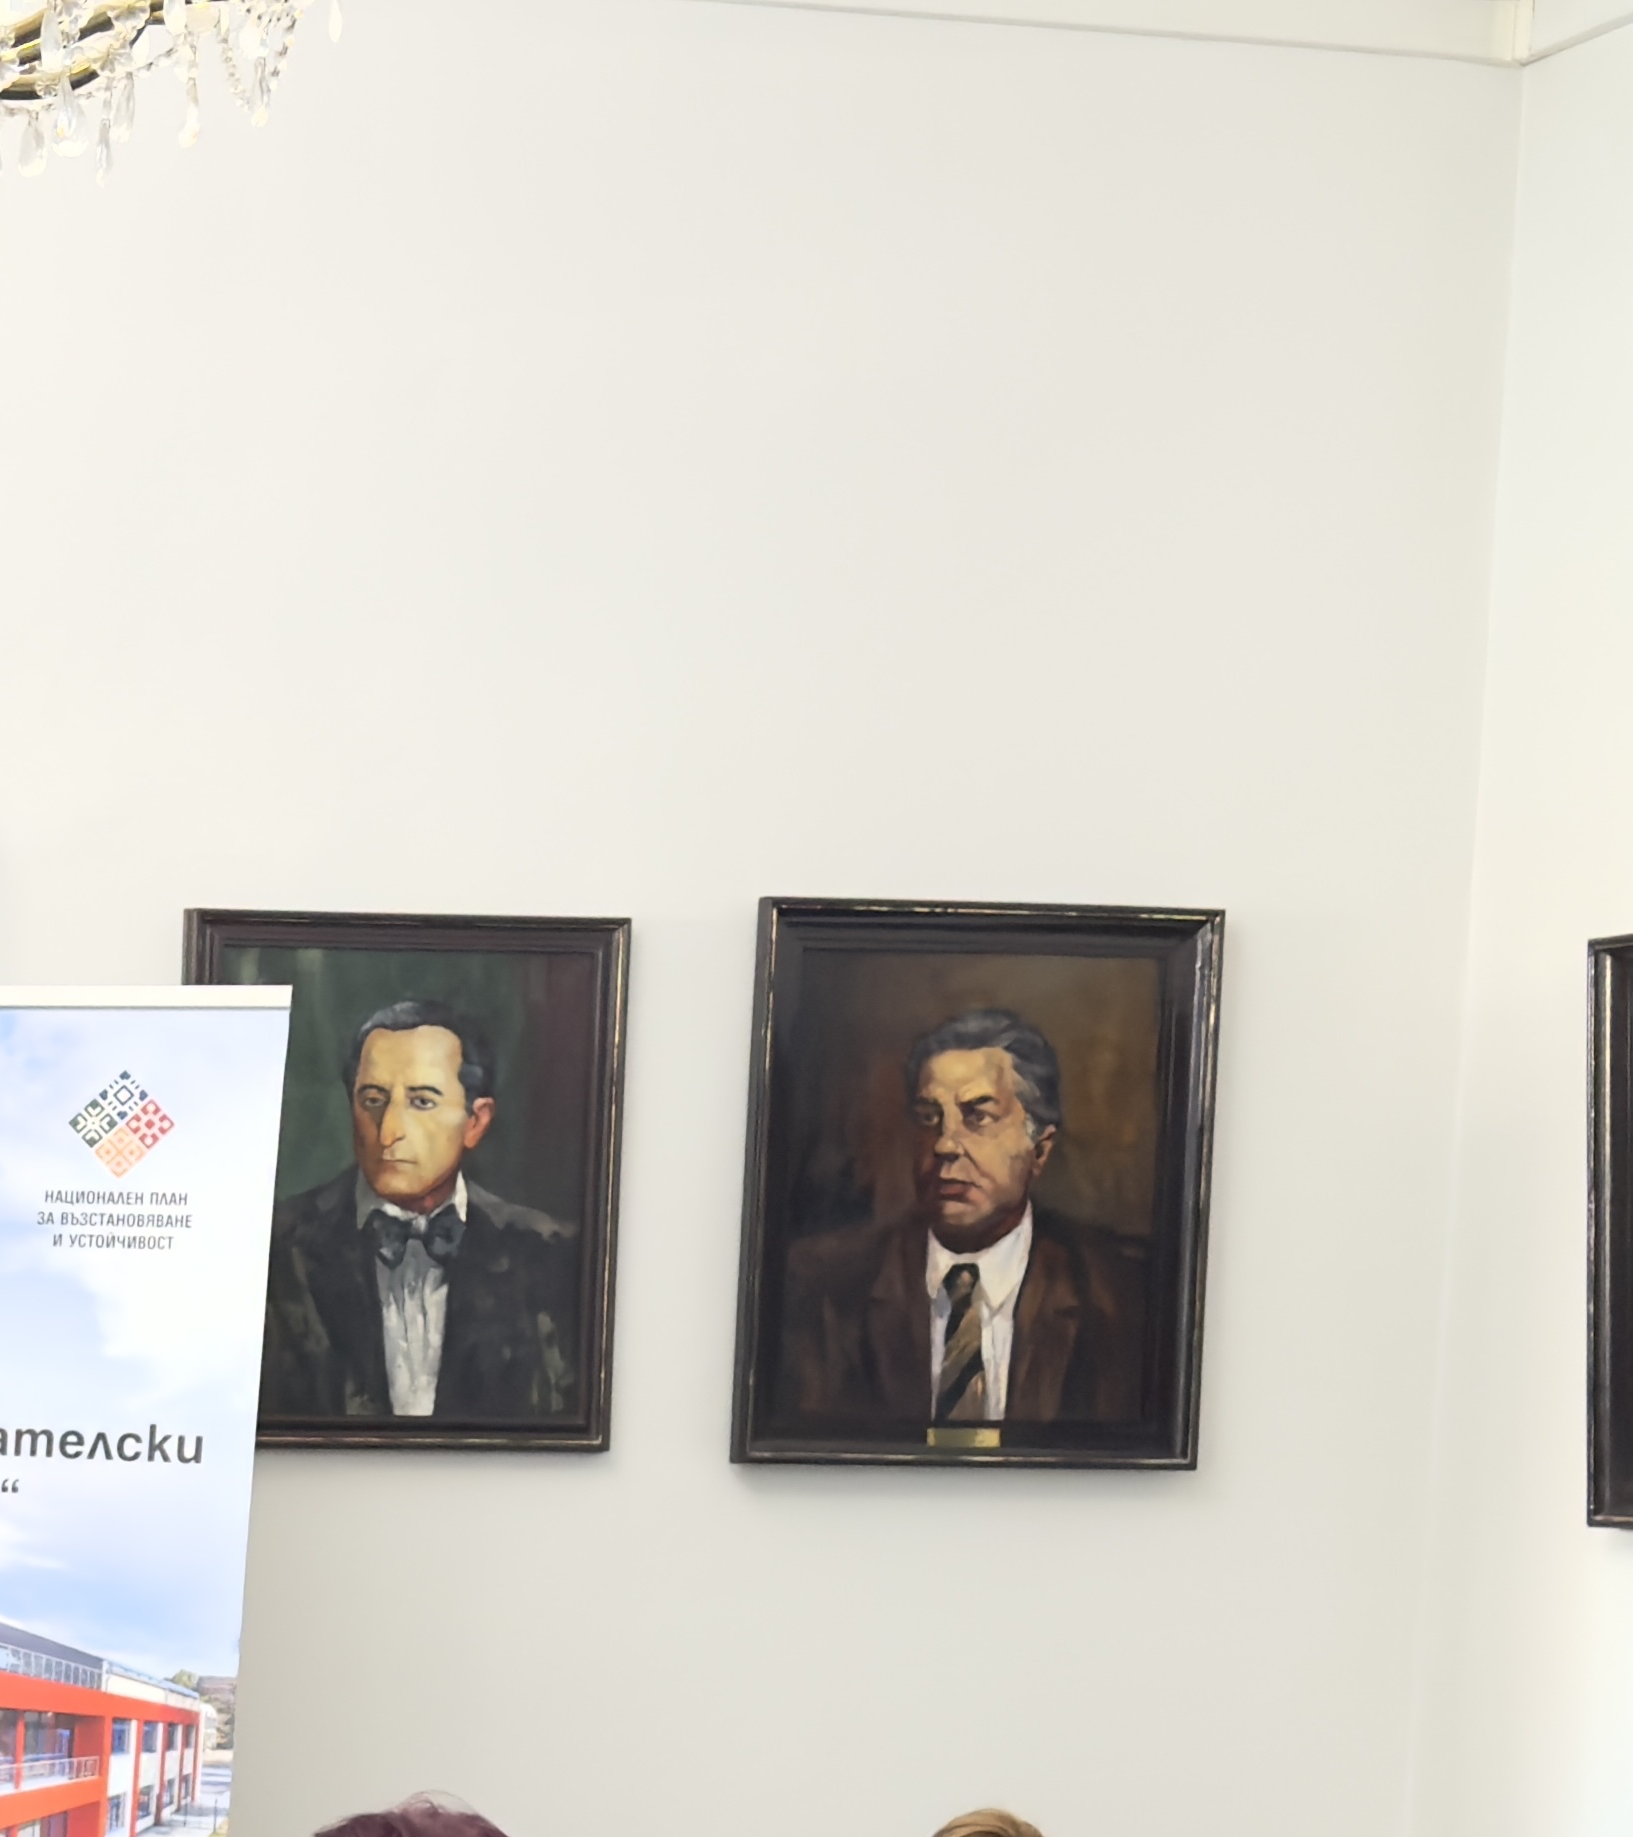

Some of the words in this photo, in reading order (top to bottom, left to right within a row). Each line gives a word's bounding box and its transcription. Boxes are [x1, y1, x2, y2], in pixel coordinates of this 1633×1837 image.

[45, 1190, 144, 1206] НАЦИОНАЛЕН
[150, 1192, 187, 1206] ПЛАН
[37, 1211, 54, 1226] ЗА
[61, 1212, 191, 1228] ВЪЗСТАНОВЯВАНЕ
[53, 1233, 62, 1247] И
[69, 1234, 173, 1250] УСТОЙЧИВОСТ
